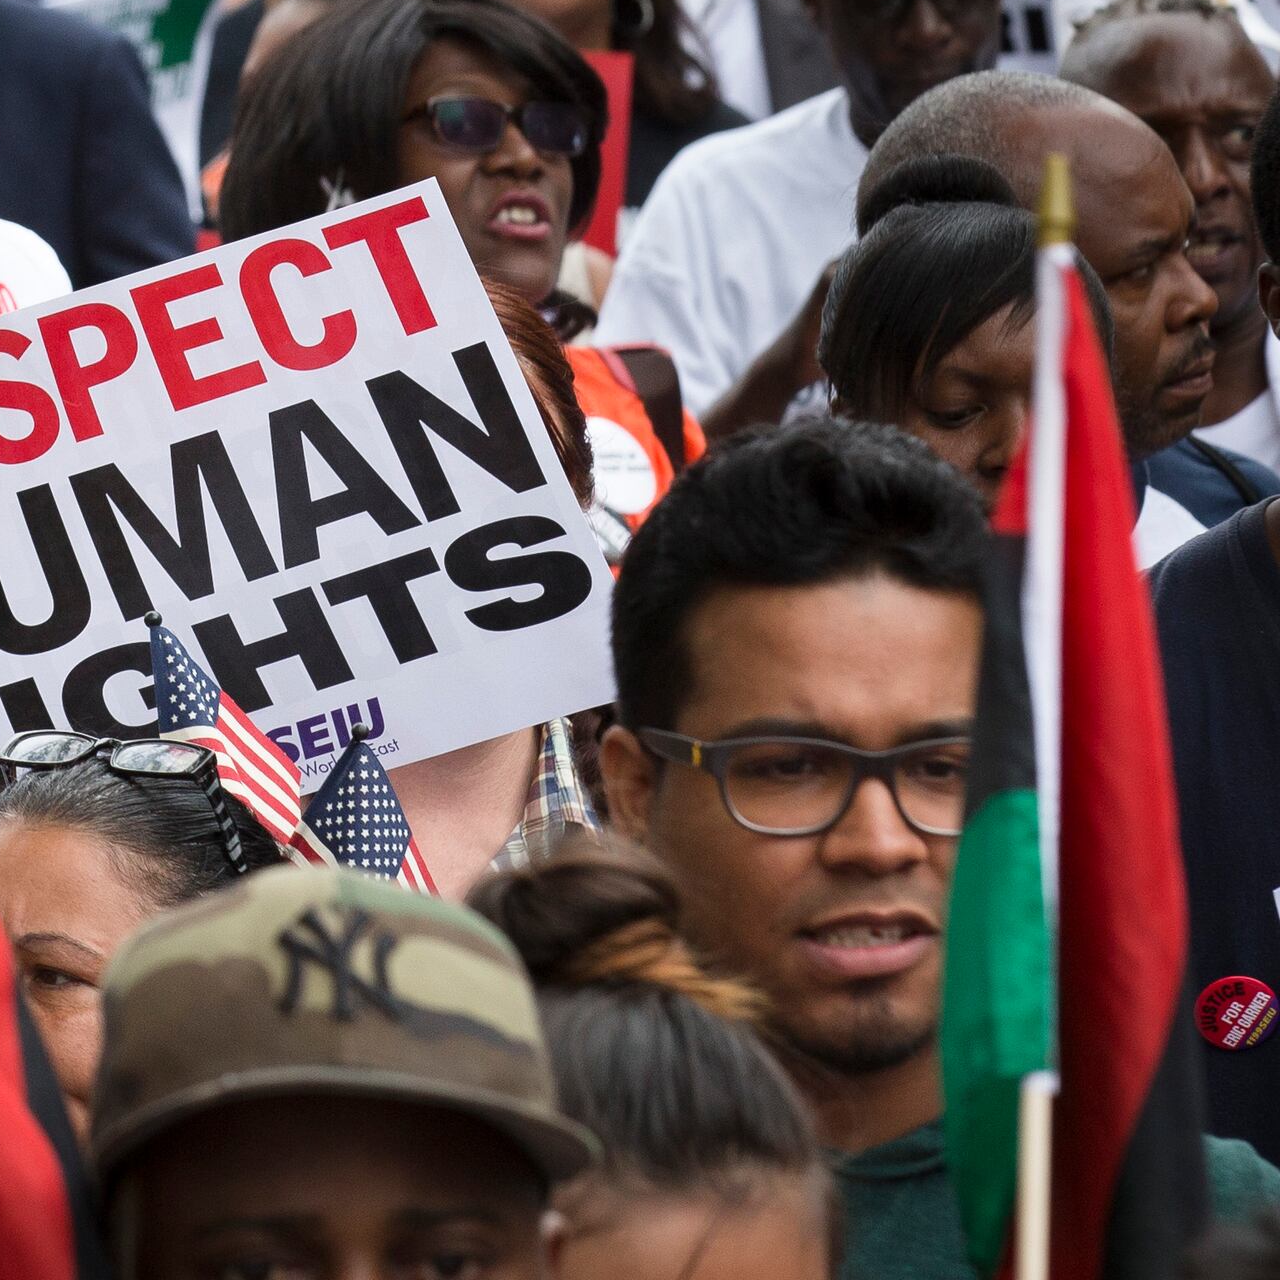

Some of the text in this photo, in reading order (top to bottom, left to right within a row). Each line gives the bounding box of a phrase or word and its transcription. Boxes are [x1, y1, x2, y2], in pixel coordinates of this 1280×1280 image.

[1200, 981, 1246, 1033] JUSTICE
[1221, 1001, 1245, 1025] FOR
[1221, 991, 1272, 1048] ERIC GARNER
